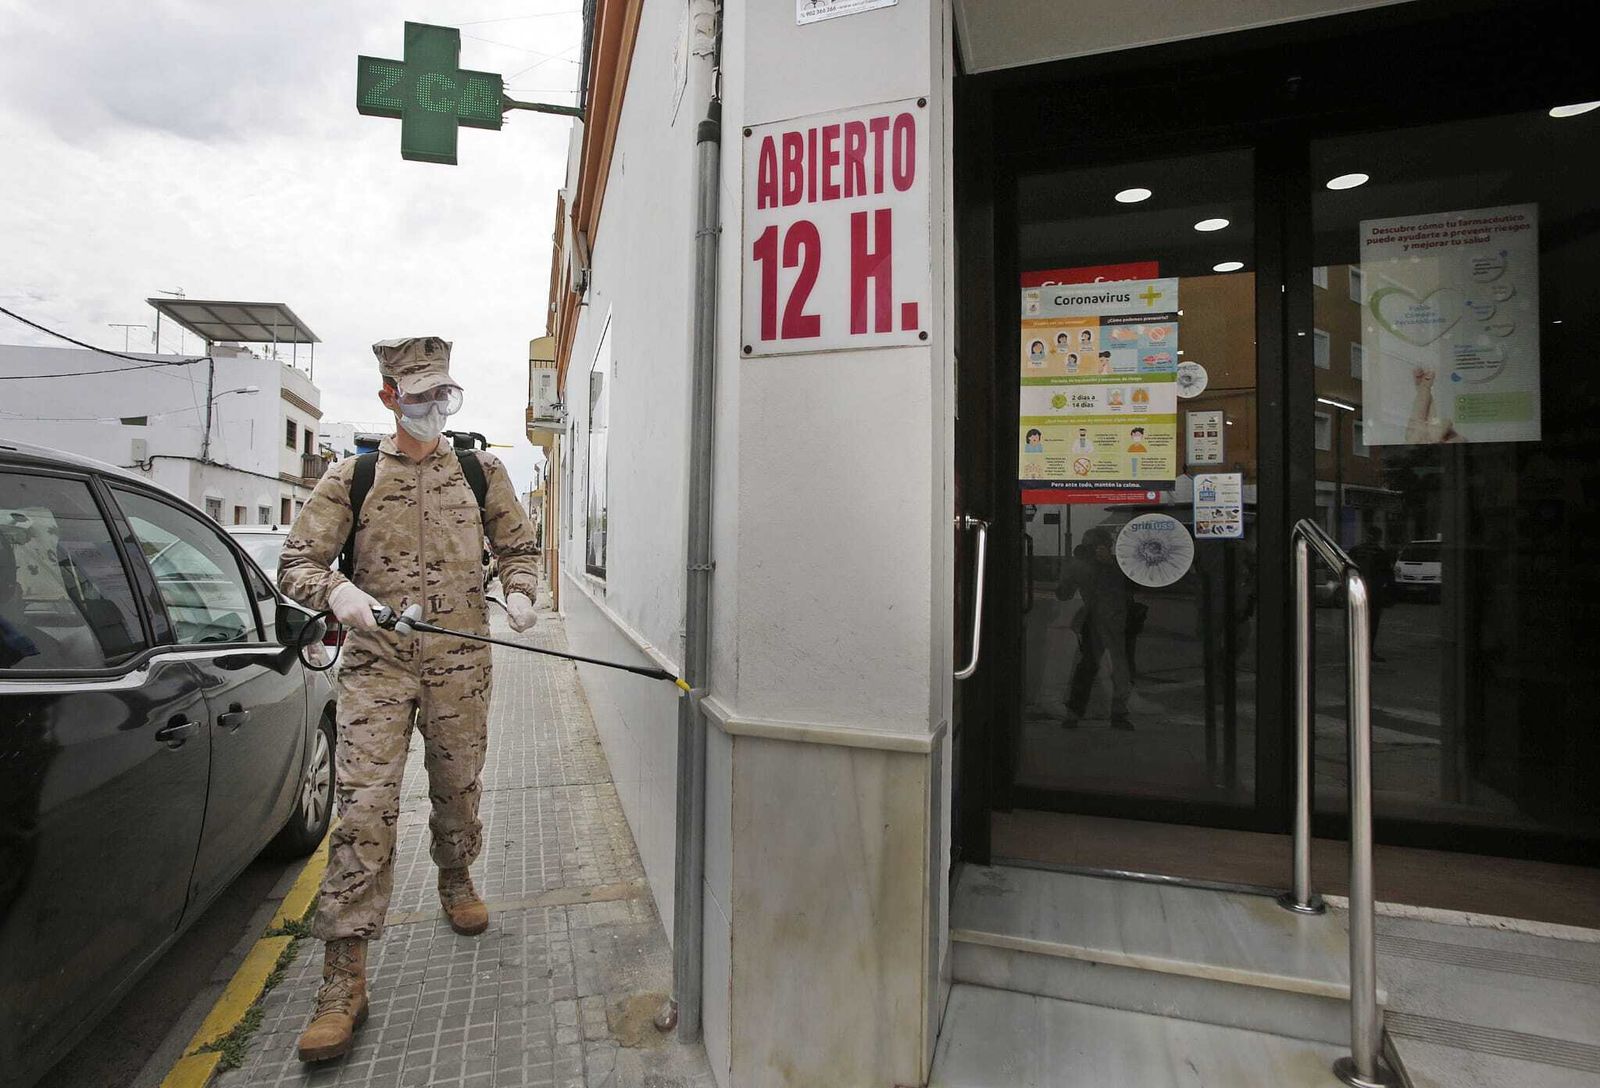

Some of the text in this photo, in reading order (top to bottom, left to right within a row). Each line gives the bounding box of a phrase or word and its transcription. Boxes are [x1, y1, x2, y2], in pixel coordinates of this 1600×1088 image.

[364, 64, 496, 119] ZCA
[757, 112, 916, 210] ABIERTO
[1366, 235, 1396, 246] puede
[1397, 230, 1440, 243] ayudarte
[1450, 226, 1492, 239] prevenir
[1494, 221, 1530, 233] riesgos
[1372, 224, 1416, 236] Descubre
[1446, 220, 1457, 229] tu
[1402, 235, 1490, 252] y mejorar tu salud
[752, 208, 919, 341] 12 H.
[1054, 291, 1131, 306] Coronavirus
